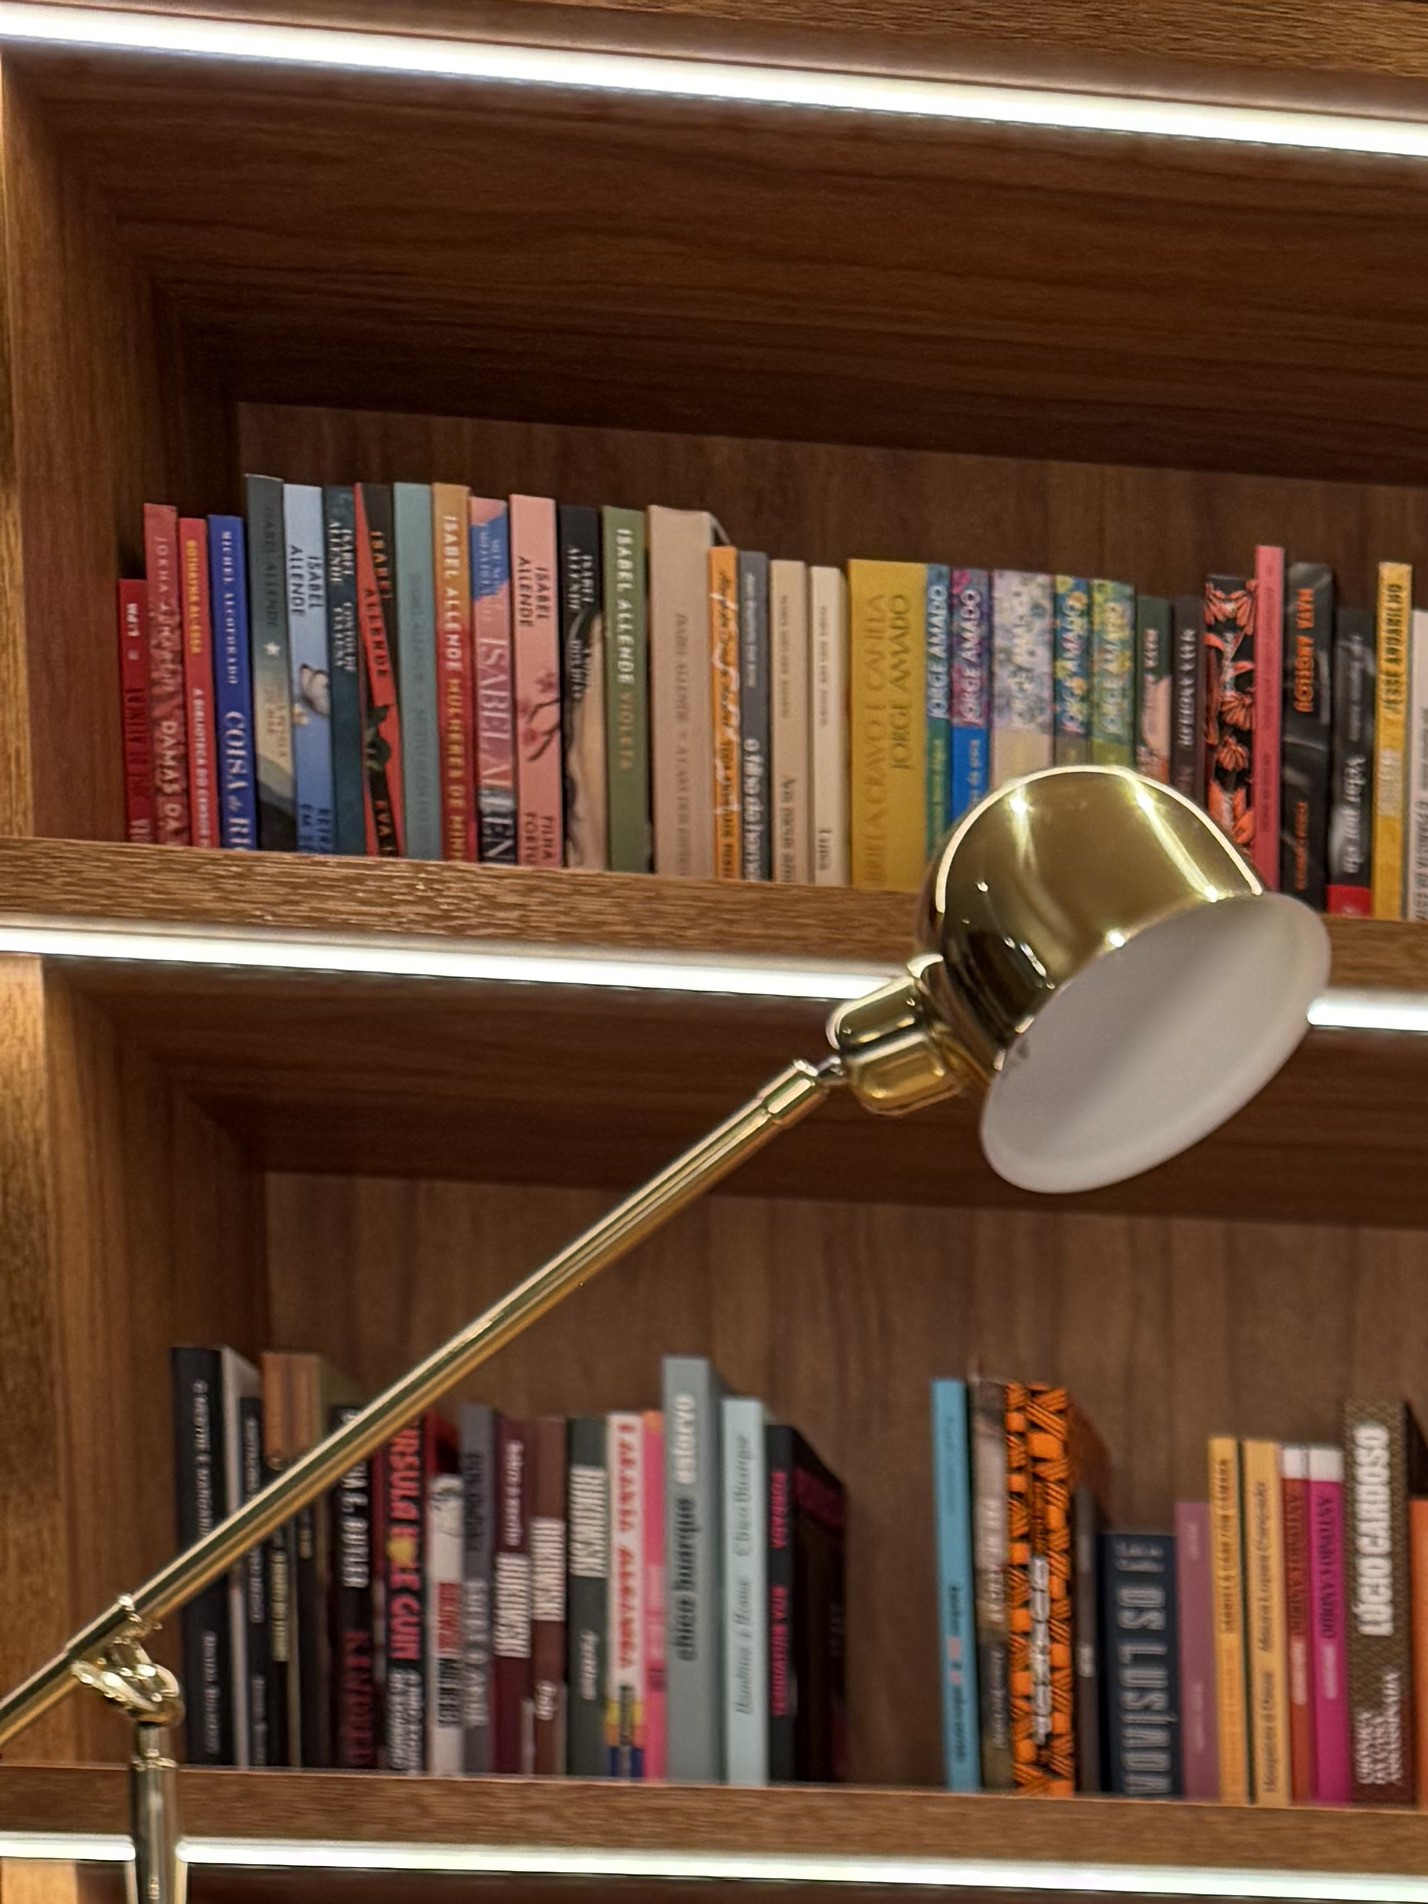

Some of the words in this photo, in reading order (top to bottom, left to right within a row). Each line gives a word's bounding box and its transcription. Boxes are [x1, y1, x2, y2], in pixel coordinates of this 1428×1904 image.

[220, 530, 236, 585] MICHEL
[289, 544, 308, 618] ALLENDE
[328, 519, 344, 584] ALLENDE
[341, 528, 356, 577] ISABEL
[369, 530, 393, 599] ISABEL
[444, 516, 462, 578] ISABEL
[567, 544, 582, 610] ALLENDE
[580, 553, 595, 603] ISABEL
[616, 527, 635, 592] ISABEL
[306, 555, 326, 610] ISABEL
[517, 555, 536, 629] ALLENDE
[533, 566, 551, 621] ISABEL
[1295, 587, 1314, 629] MAYA
[364, 587, 390, 679] ALLENDE
[445, 587, 464, 672] ALLENDE
[616, 598, 638, 684] ALLENDE
[888, 594, 912, 694] AMADO
[928, 584, 948, 658] AMADO
[959, 588, 982, 663] AMADO
[478, 637, 512, 749] ISABEL
[928, 661, 949, 719] JORGE
[959, 666, 982, 724] JORGE
[1293, 635, 1314, 713] ANGELOU
[162, 721, 181, 794] DAMAS
[222, 711, 248, 789] COISA
[446, 679, 467, 778] MULHERES
[891, 702, 917, 771] JORGE
[163, 802, 181, 831] DA
[447, 785, 466, 813] DE
[1353, 1425, 1392, 1557] CARDOSO
[390, 1593, 422, 1660] GUIN
[1116, 1585, 1167, 1630] OS
[1351, 1558, 1394, 1637] LÚCIO
